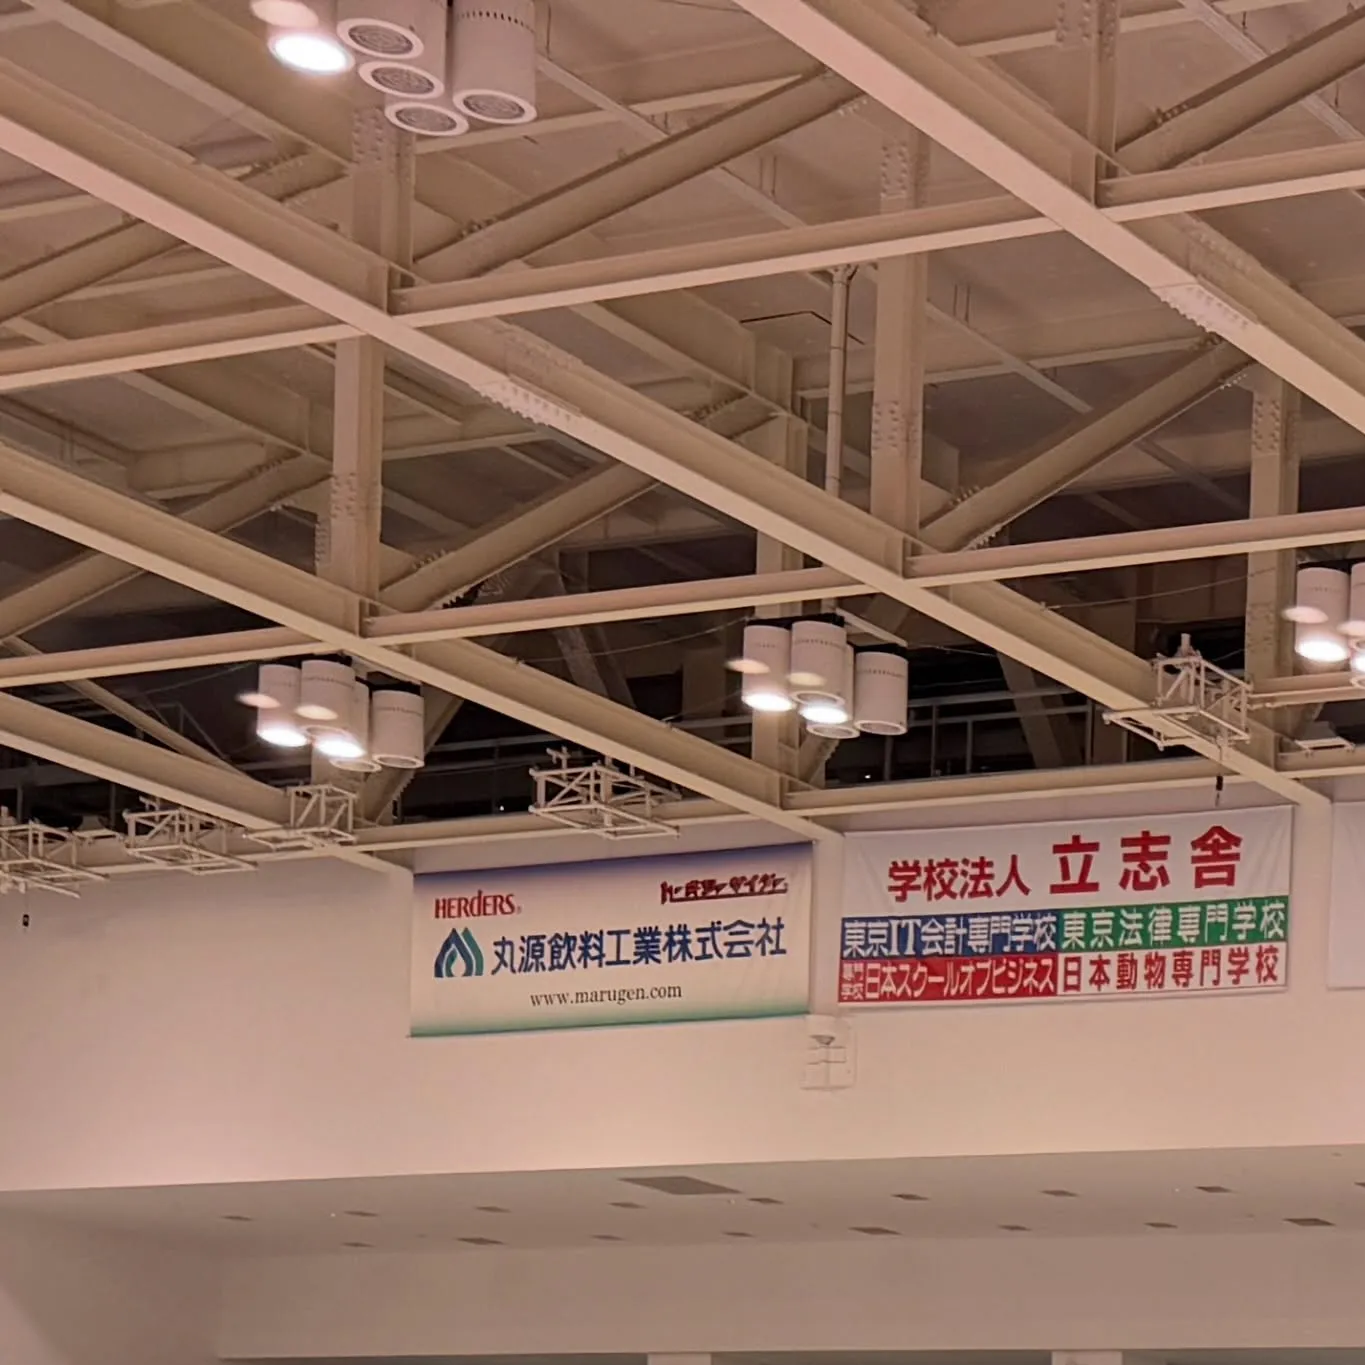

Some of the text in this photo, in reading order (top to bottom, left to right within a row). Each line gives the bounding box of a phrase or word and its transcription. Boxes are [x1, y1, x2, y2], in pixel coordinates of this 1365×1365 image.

[887, 825, 1243, 902] 学校法人 立志舎
[491, 916, 787, 976] 丸源飲料工業株式会社
[1062, 899, 1286, 949] 東京法律専門学校
[1062, 944, 1280, 993] 日本動物専門学校
[529, 983, 683, 1007] www.marugen.com
